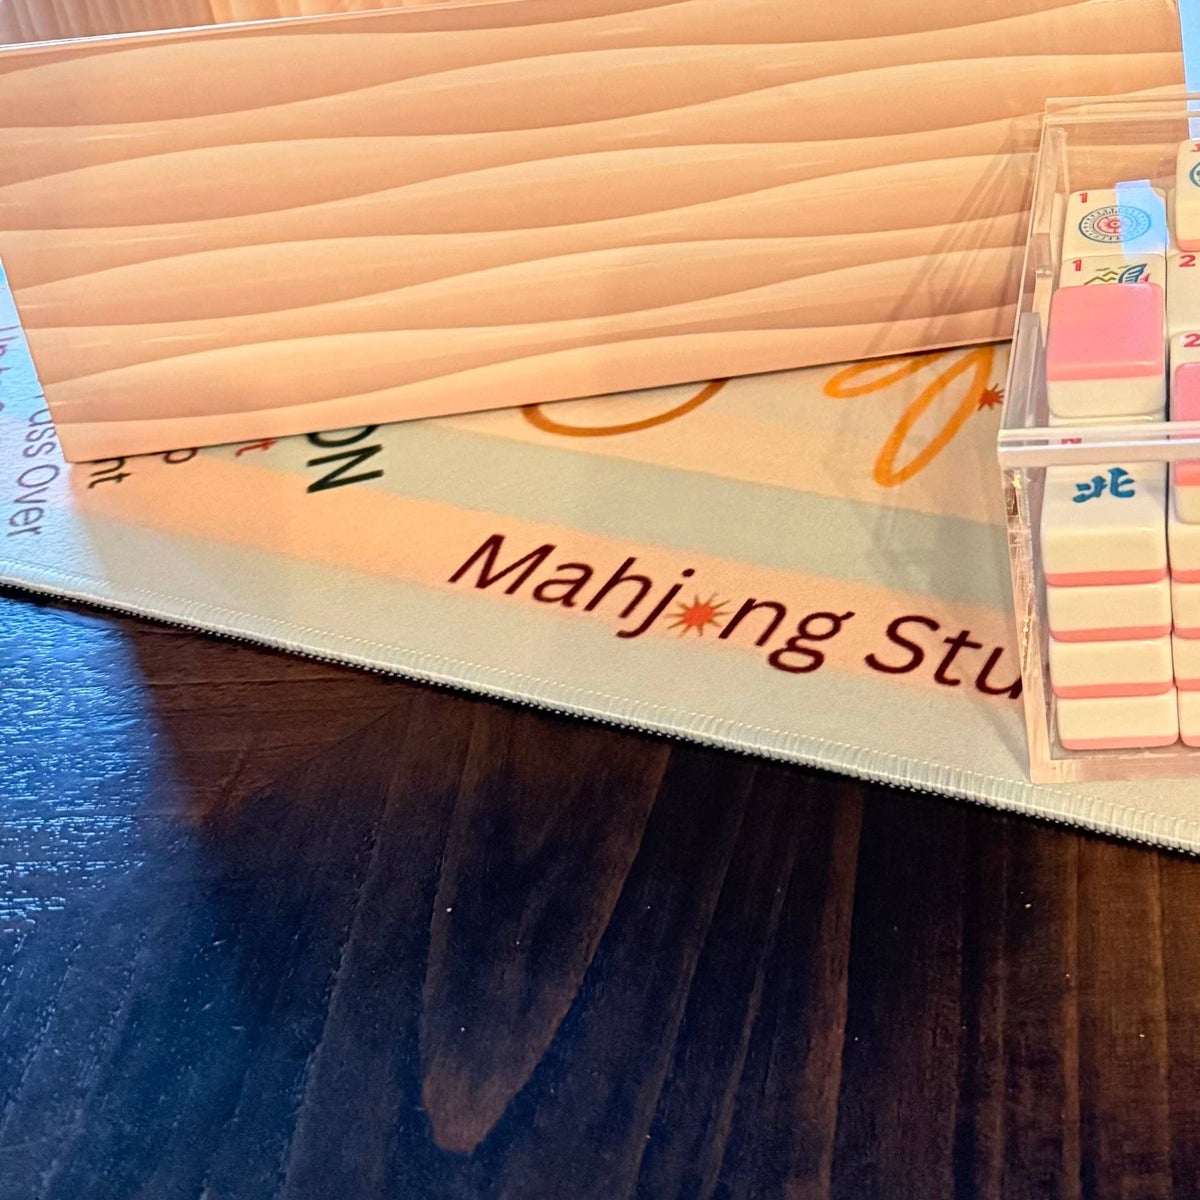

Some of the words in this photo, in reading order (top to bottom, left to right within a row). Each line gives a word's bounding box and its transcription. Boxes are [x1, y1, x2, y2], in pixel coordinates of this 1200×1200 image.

[1079, 192, 1089, 203] 1
[1073, 259, 1082, 271] 1
[1179, 254, 1196, 267] 2
[1073, 466, 1135, 504] 北
[6, 463, 60, 537] Over
